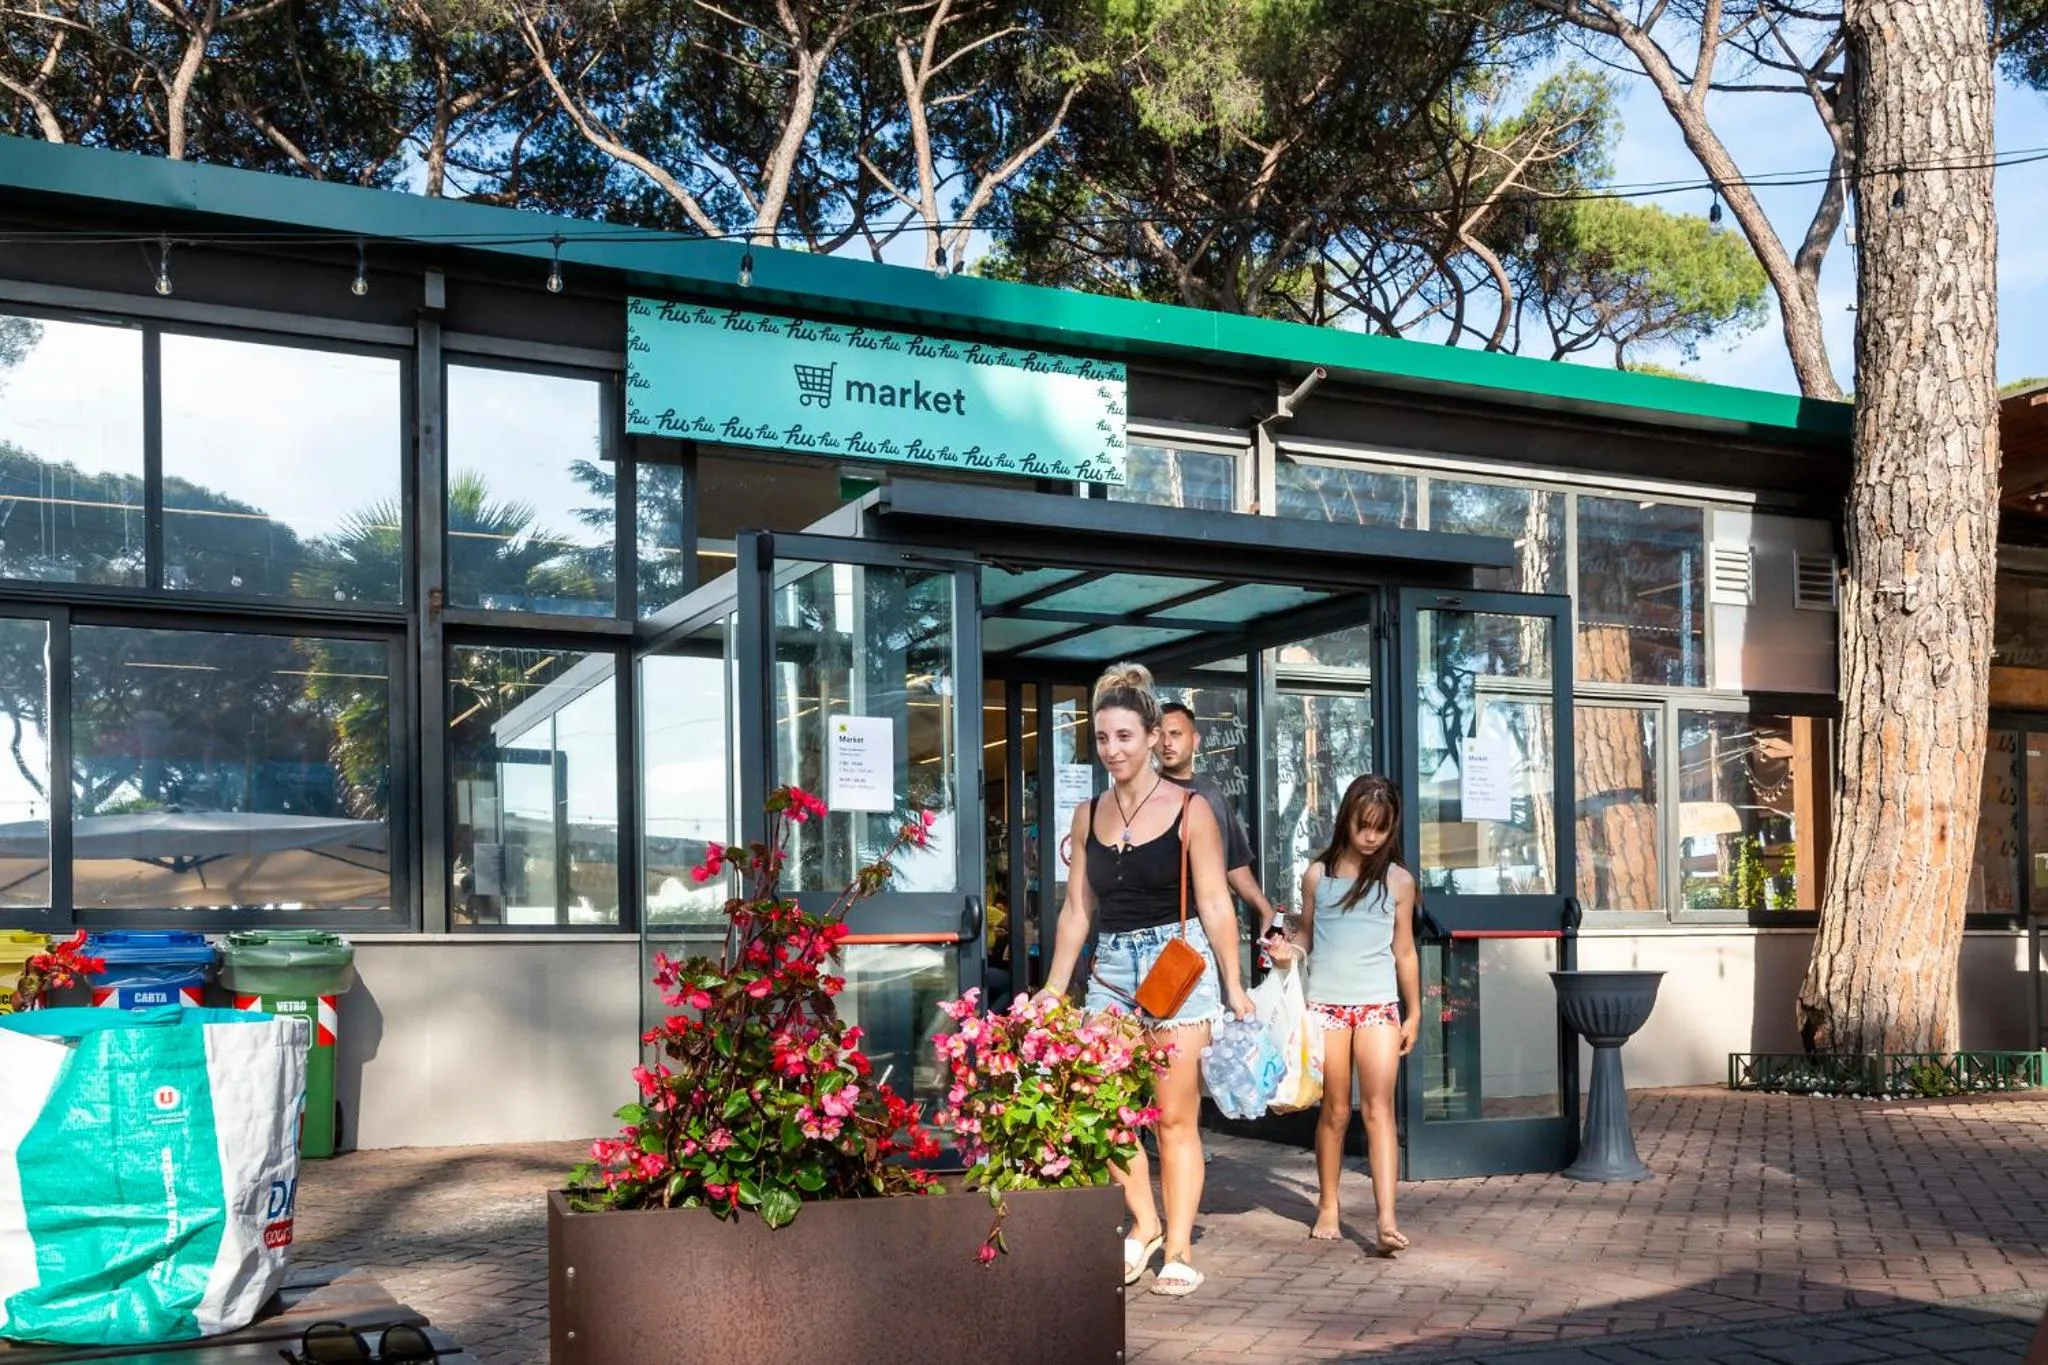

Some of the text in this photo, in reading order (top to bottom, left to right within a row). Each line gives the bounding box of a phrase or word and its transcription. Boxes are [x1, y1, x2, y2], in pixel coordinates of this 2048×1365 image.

[628, 299, 1126, 383] hu hu hu hu hu hu hu hu hu hu hu hu hu hu hu hu hu
[628, 335, 651, 353] hu
[628, 372, 650, 388] hu
[846, 380, 966, 416] market
[628, 408, 1124, 481] hu hu hu hu hu hu hu hu hu hu hu hu hu hu hu hu hu
[839, 735, 863, 743] Market
[134, 992, 167, 1003] CARTA
[276, 1000, 307, 1012] VETRO
